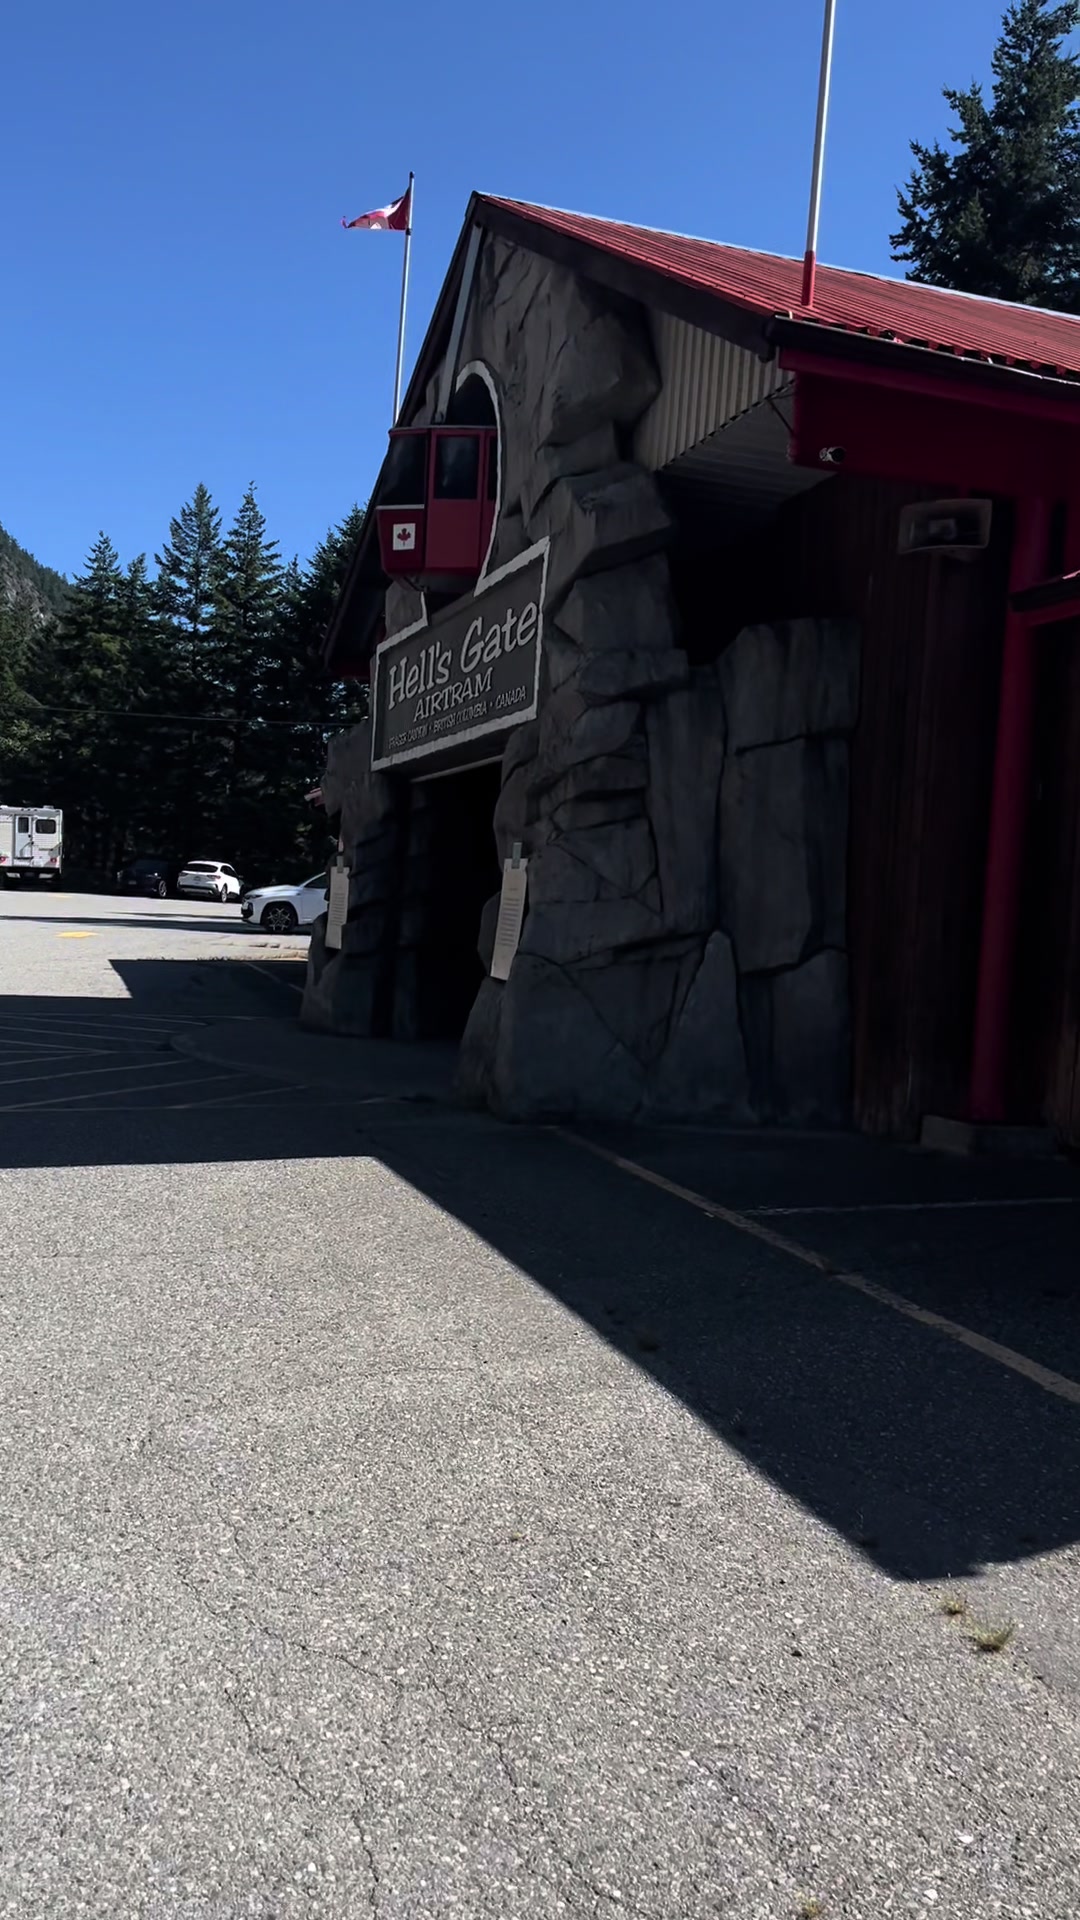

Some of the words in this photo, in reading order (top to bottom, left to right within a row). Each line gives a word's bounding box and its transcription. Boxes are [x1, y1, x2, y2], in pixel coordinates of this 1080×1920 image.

[388, 641, 452, 710] Hell's
[460, 601, 539, 673] Gate
[413, 667, 494, 723] AIRTRAM
[495, 686, 526, 709] CANADA
